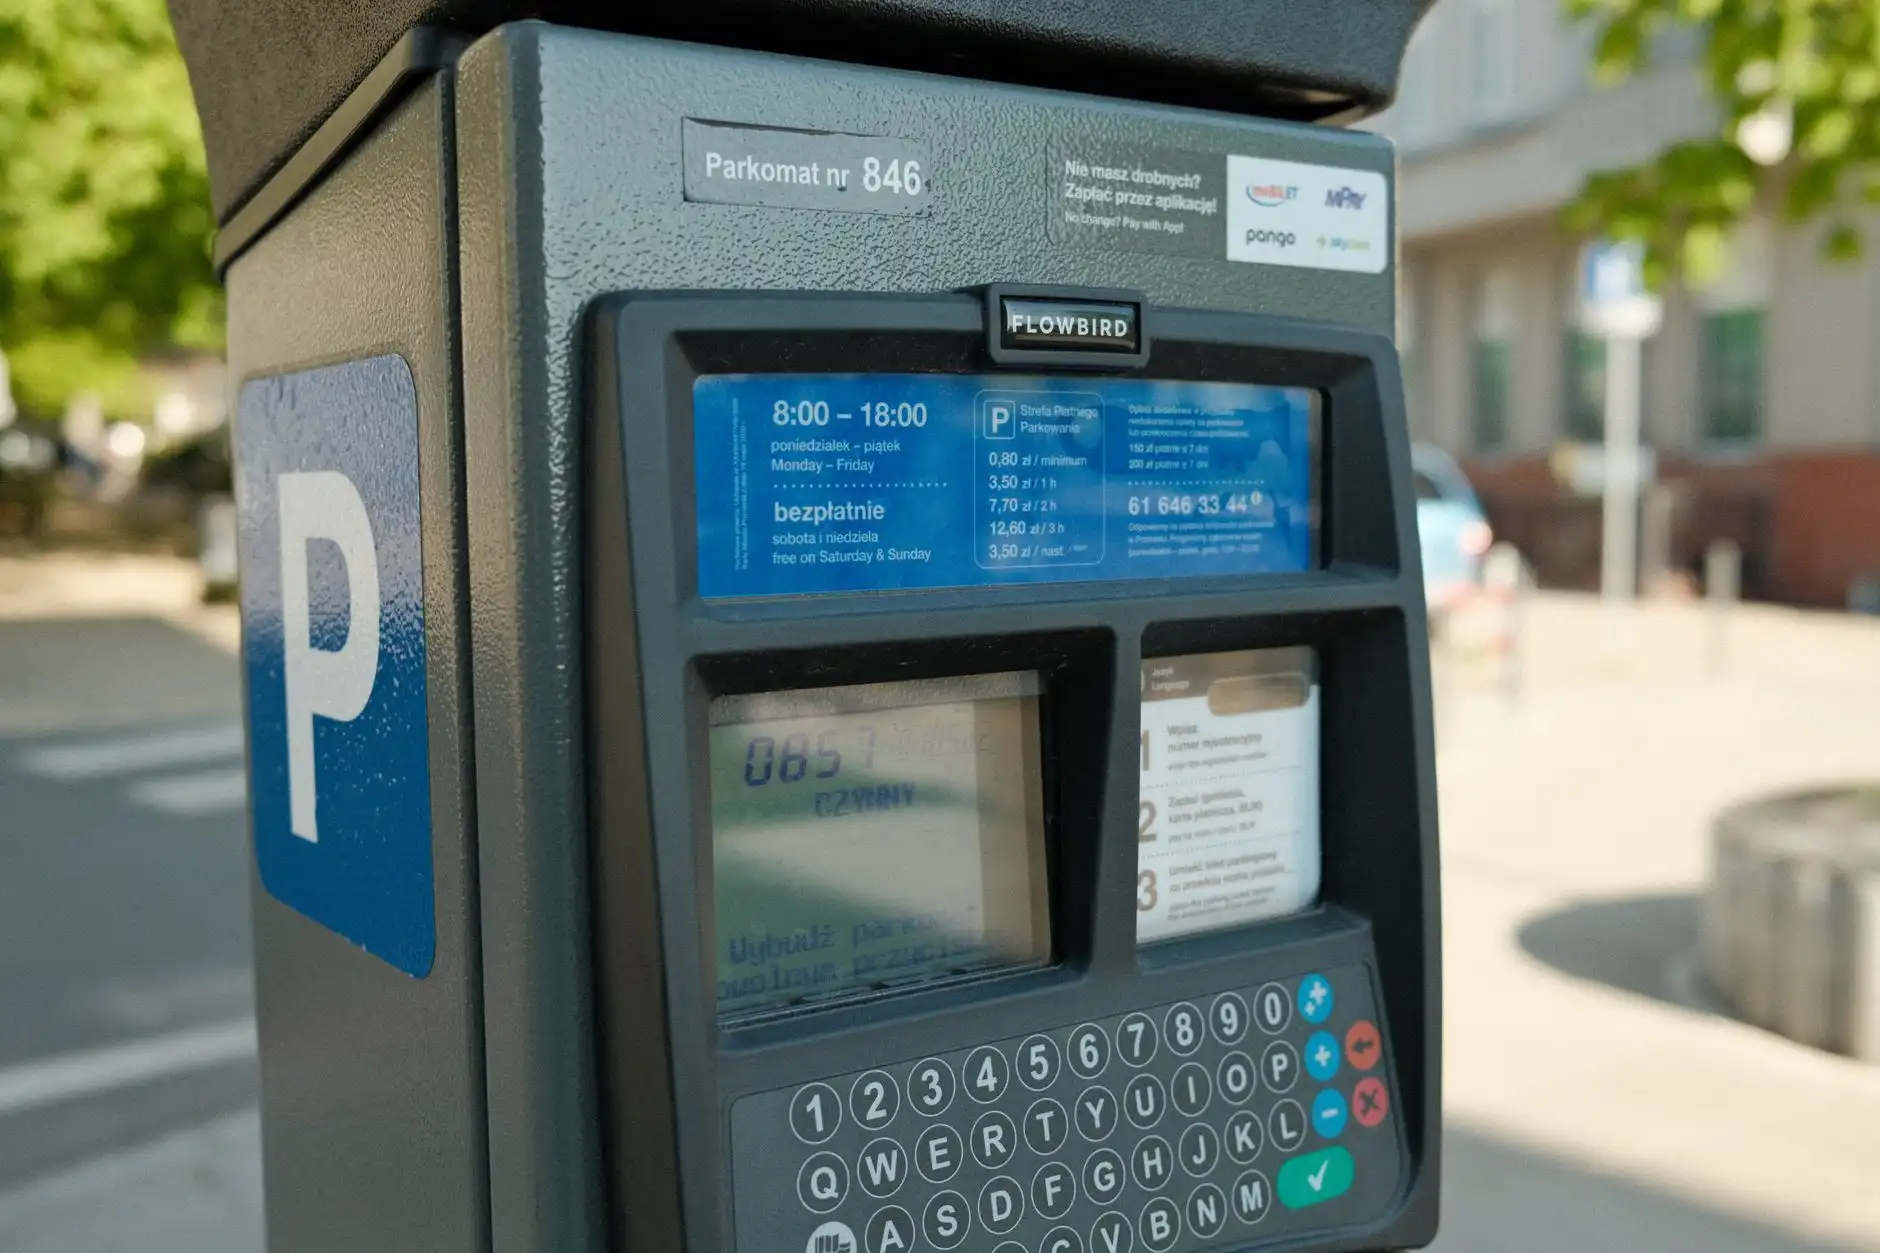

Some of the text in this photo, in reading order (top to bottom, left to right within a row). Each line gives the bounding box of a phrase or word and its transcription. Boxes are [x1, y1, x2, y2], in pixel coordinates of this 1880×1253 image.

[705, 152, 922, 196] Parkomat nr 846
[1065, 160, 1202, 190] Nie masz drobnych?
[1065, 182, 1113, 202] Zapłać
[1115, 190, 1154, 206] przez
[1246, 229, 1296, 247] pango
[1012, 314, 1128, 338] FLOWBIRD
[772, 400, 830, 427] 8:00
[860, 402, 928, 428] 18:00
[992, 407, 1009, 433] P
[1020, 404, 1052, 417] Strefa
[1020, 421, 1081, 434] Parkowania
[771, 439, 850, 454] poniedziałek
[864, 440, 901, 455] piątek
[771, 458, 822, 473] Monday
[837, 459, 875, 474] Friday
[988, 452, 1018, 467] 0,80
[1022, 455, 1031, 466] zł
[1041, 456, 1087, 466] minimum
[988, 475, 1018, 491] 3,50
[1050, 477, 1057, 489] h
[774, 501, 885, 525] bezpłatnie
[988, 498, 1019, 514] 7,70
[1050, 500, 1057, 511] h
[1128, 497, 1149, 515] 61
[1158, 496, 1191, 514] 646
[1198, 496, 1220, 514] 33
[1226, 495, 1248, 513] 44
[772, 532, 817, 545] sobota
[826, 530, 879, 543] niedziela
[989, 521, 1026, 537] 12,60
[1058, 521, 1065, 533] h
[772, 548, 932, 564] free on Saturday & Sunday
[988, 544, 1018, 560] 3,50
[279, 471, 379, 843] P
[1138, 800, 1157, 843] 2
[1137, 869, 1158, 912] 3
[806, 992, 1282, 1132] 1 2 3 4 5 6 7 8 9 0
[810, 1053, 1289, 1200] Q W E R T Y U I O P
[880, 1112, 1298, 1253] A S D F G H J K L
[1100, 1223, 1120, 1253] V
[1149, 1209, 1171, 1241] B
[1196, 1195, 1217, 1227] N
[1240, 1181, 1263, 1213] M
